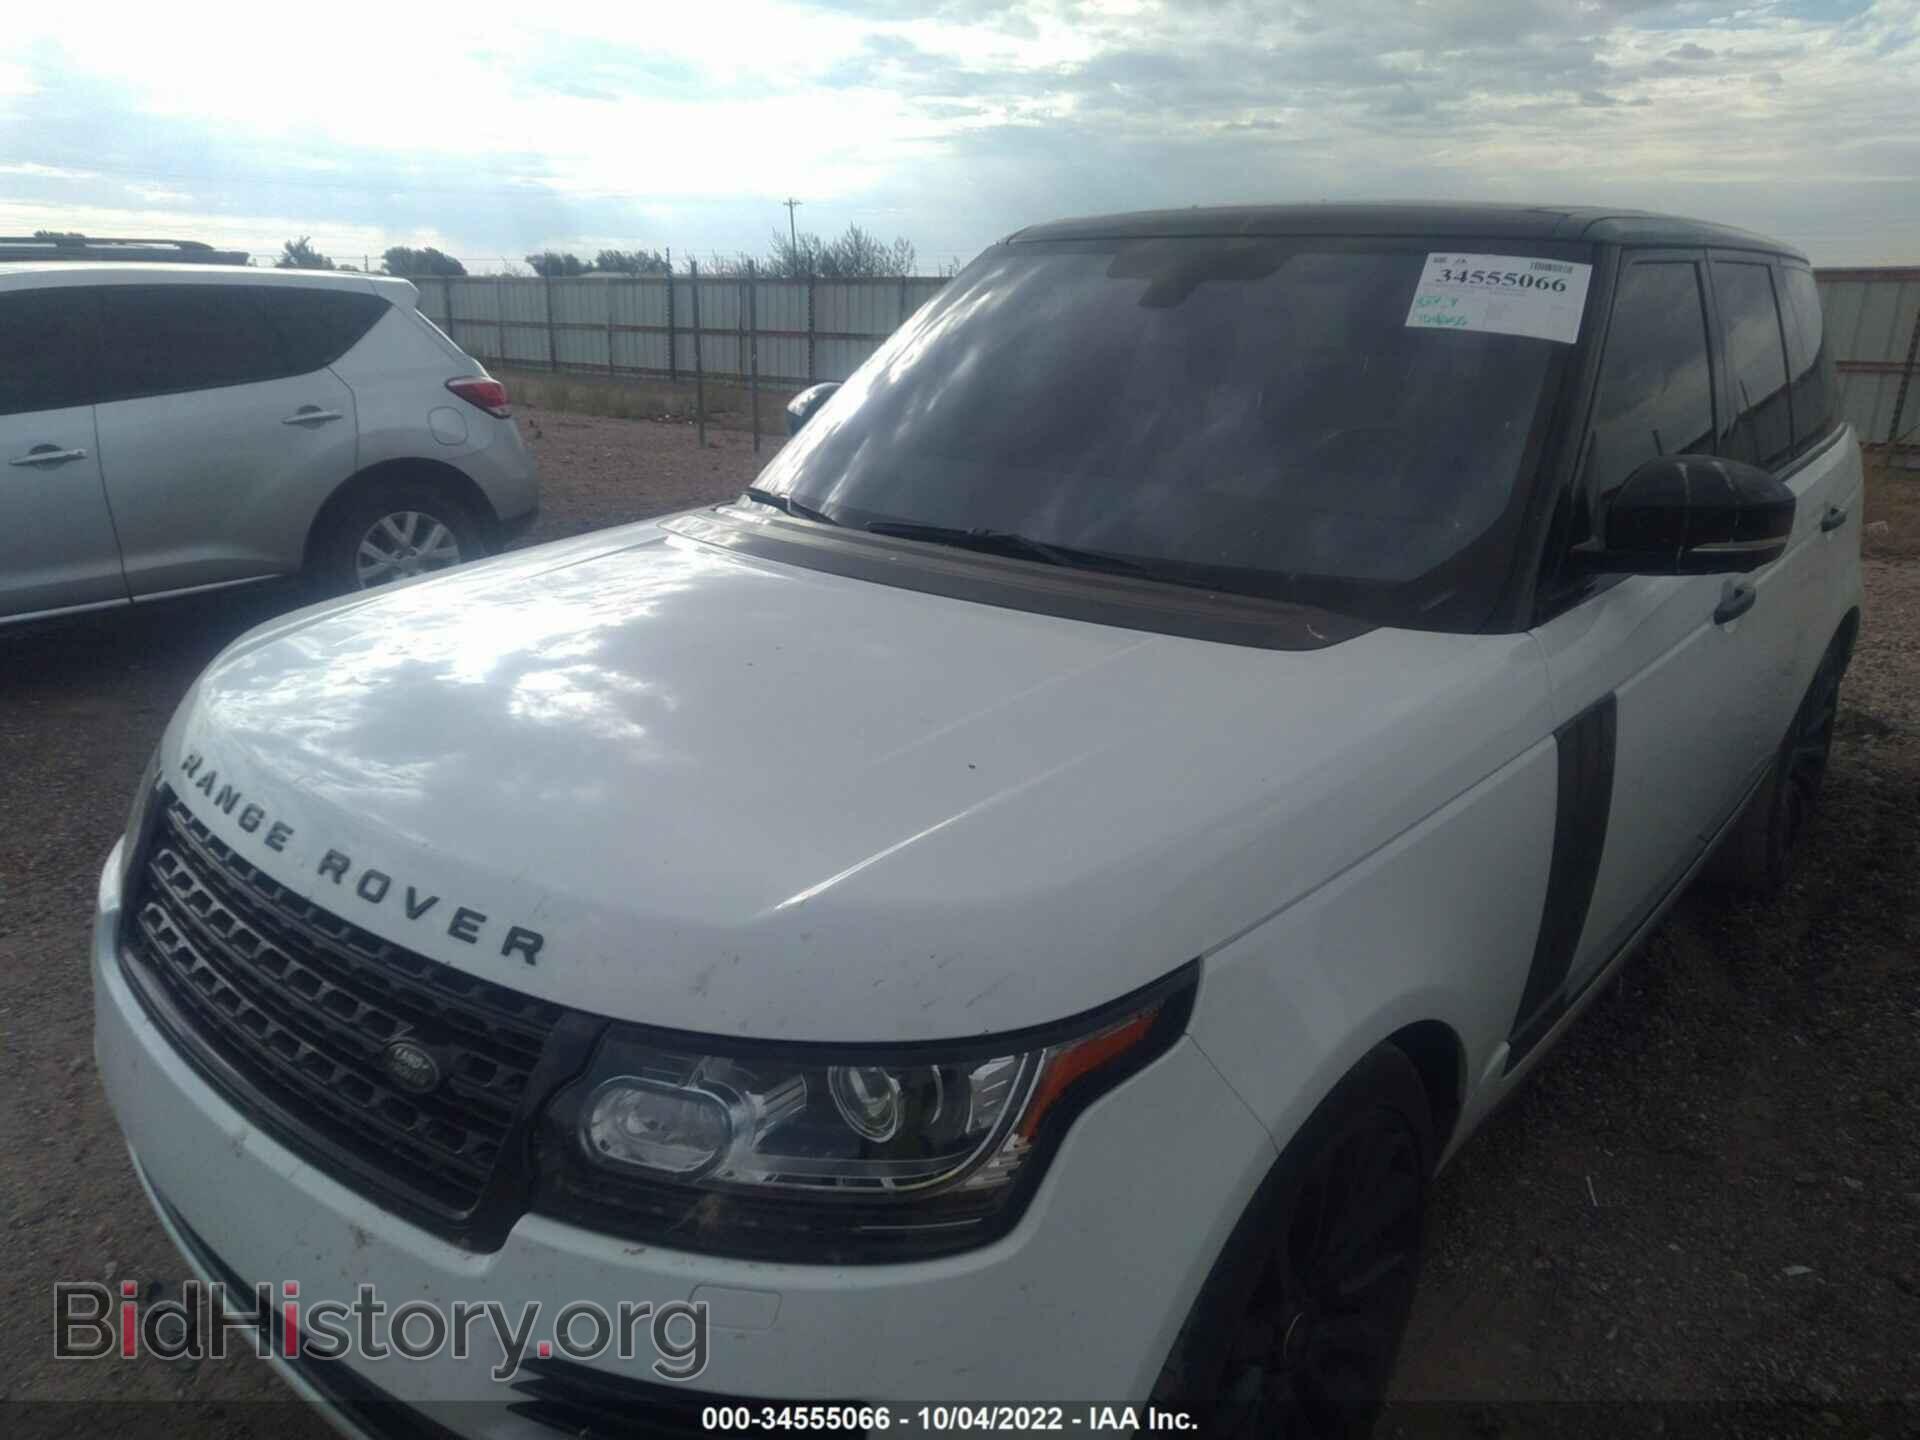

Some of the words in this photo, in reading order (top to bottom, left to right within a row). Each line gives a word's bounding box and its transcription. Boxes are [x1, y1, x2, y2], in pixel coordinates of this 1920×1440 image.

[1436, 268, 1567, 293] 34555066
[181, 752, 294, 852] RANGE
[318, 849, 544, 965] ROVER
